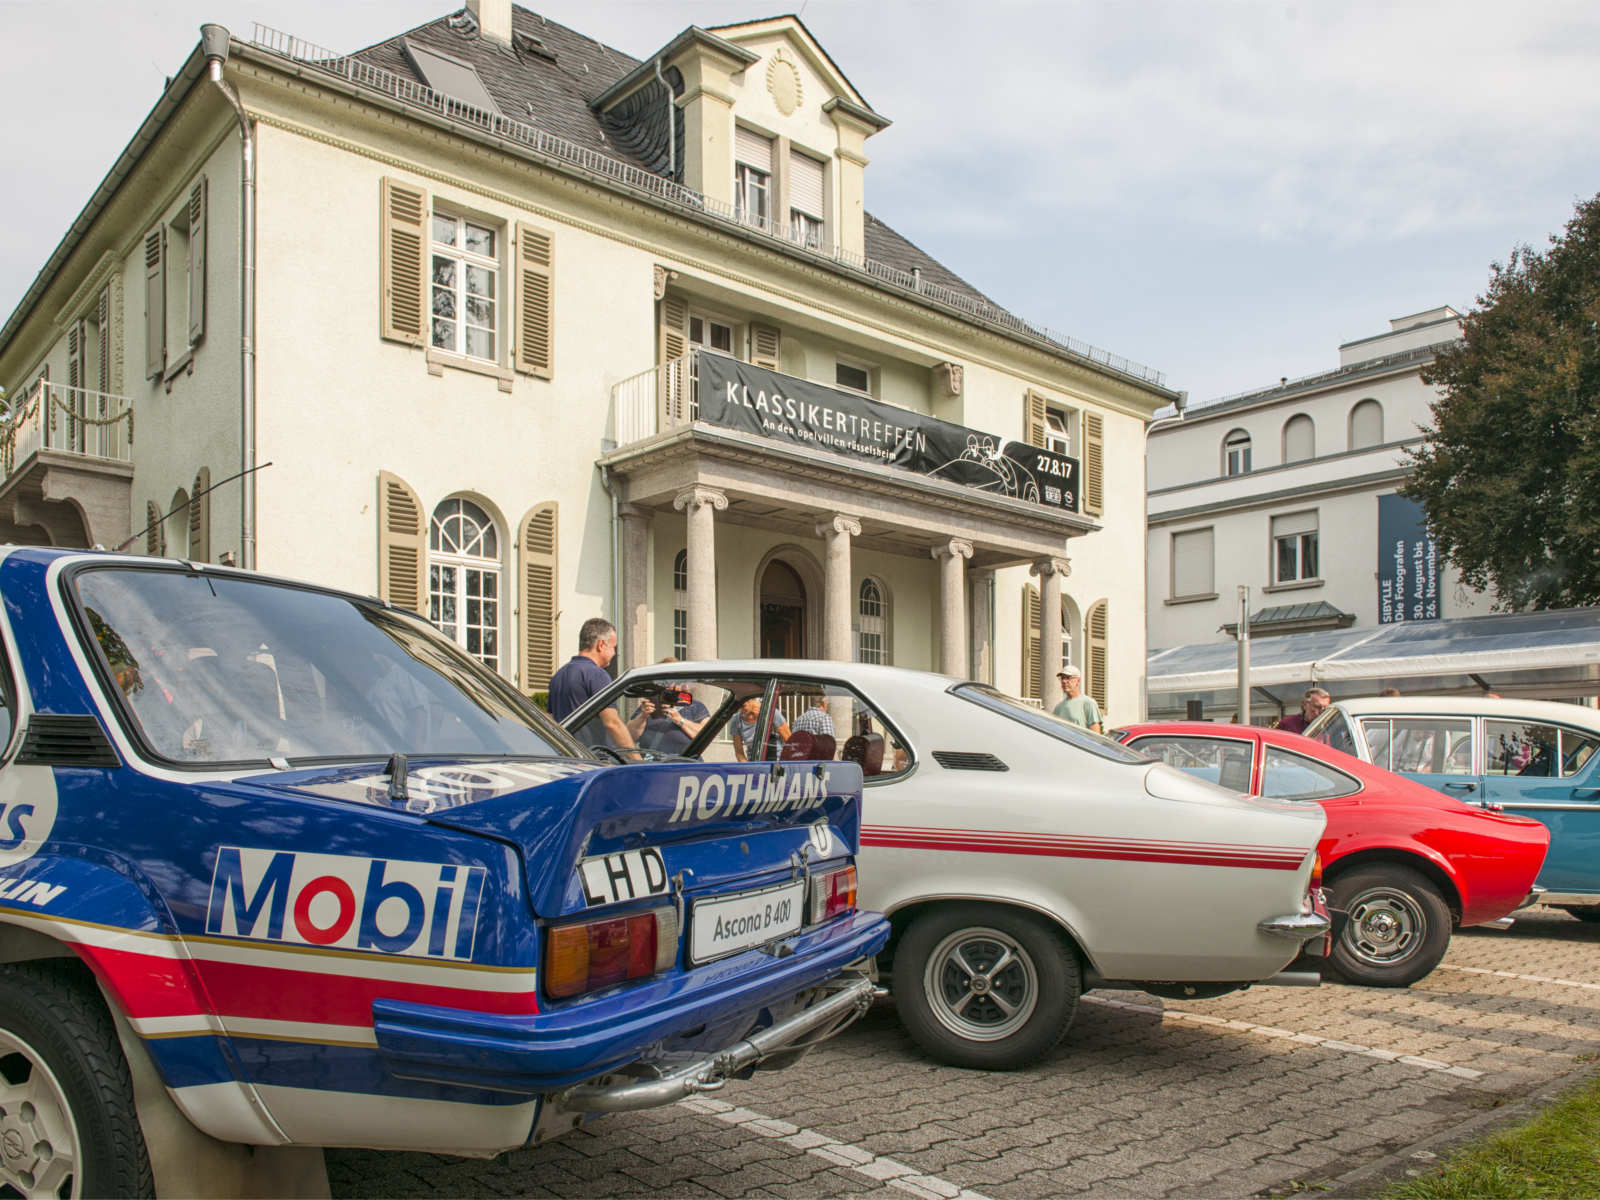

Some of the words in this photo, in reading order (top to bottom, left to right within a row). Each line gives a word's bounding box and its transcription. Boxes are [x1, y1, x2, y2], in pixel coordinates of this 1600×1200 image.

[726, 381, 926, 453] KLASSIKERTREFFEN
[762, 418, 776, 431] An
[777, 422, 794, 435] den
[797, 429, 846, 448] opelvillen
[847, 440, 897, 460] rüsselsheim
[1037, 454, 1073, 479] 27.8.17
[1393, 540, 1407, 600] Fotografen
[1412, 541, 1424, 559] bis
[1425, 540, 1436, 598] November
[1382, 579, 1392, 623] SIBYLLE
[1413, 559, 1426, 599] August
[1394, 602, 1405, 621] Die
[1413, 601, 1424, 620] 30.
[1425, 600, 1436, 618] 26.
[668, 772, 831, 823] ROTHMANS
[207, 847, 487, 959] Mobil
[712, 914, 762, 942] Ascona
[764, 903, 772, 929] B
[773, 898, 792, 925] 400
[12, 997, 64, 1052] PIRELLI
